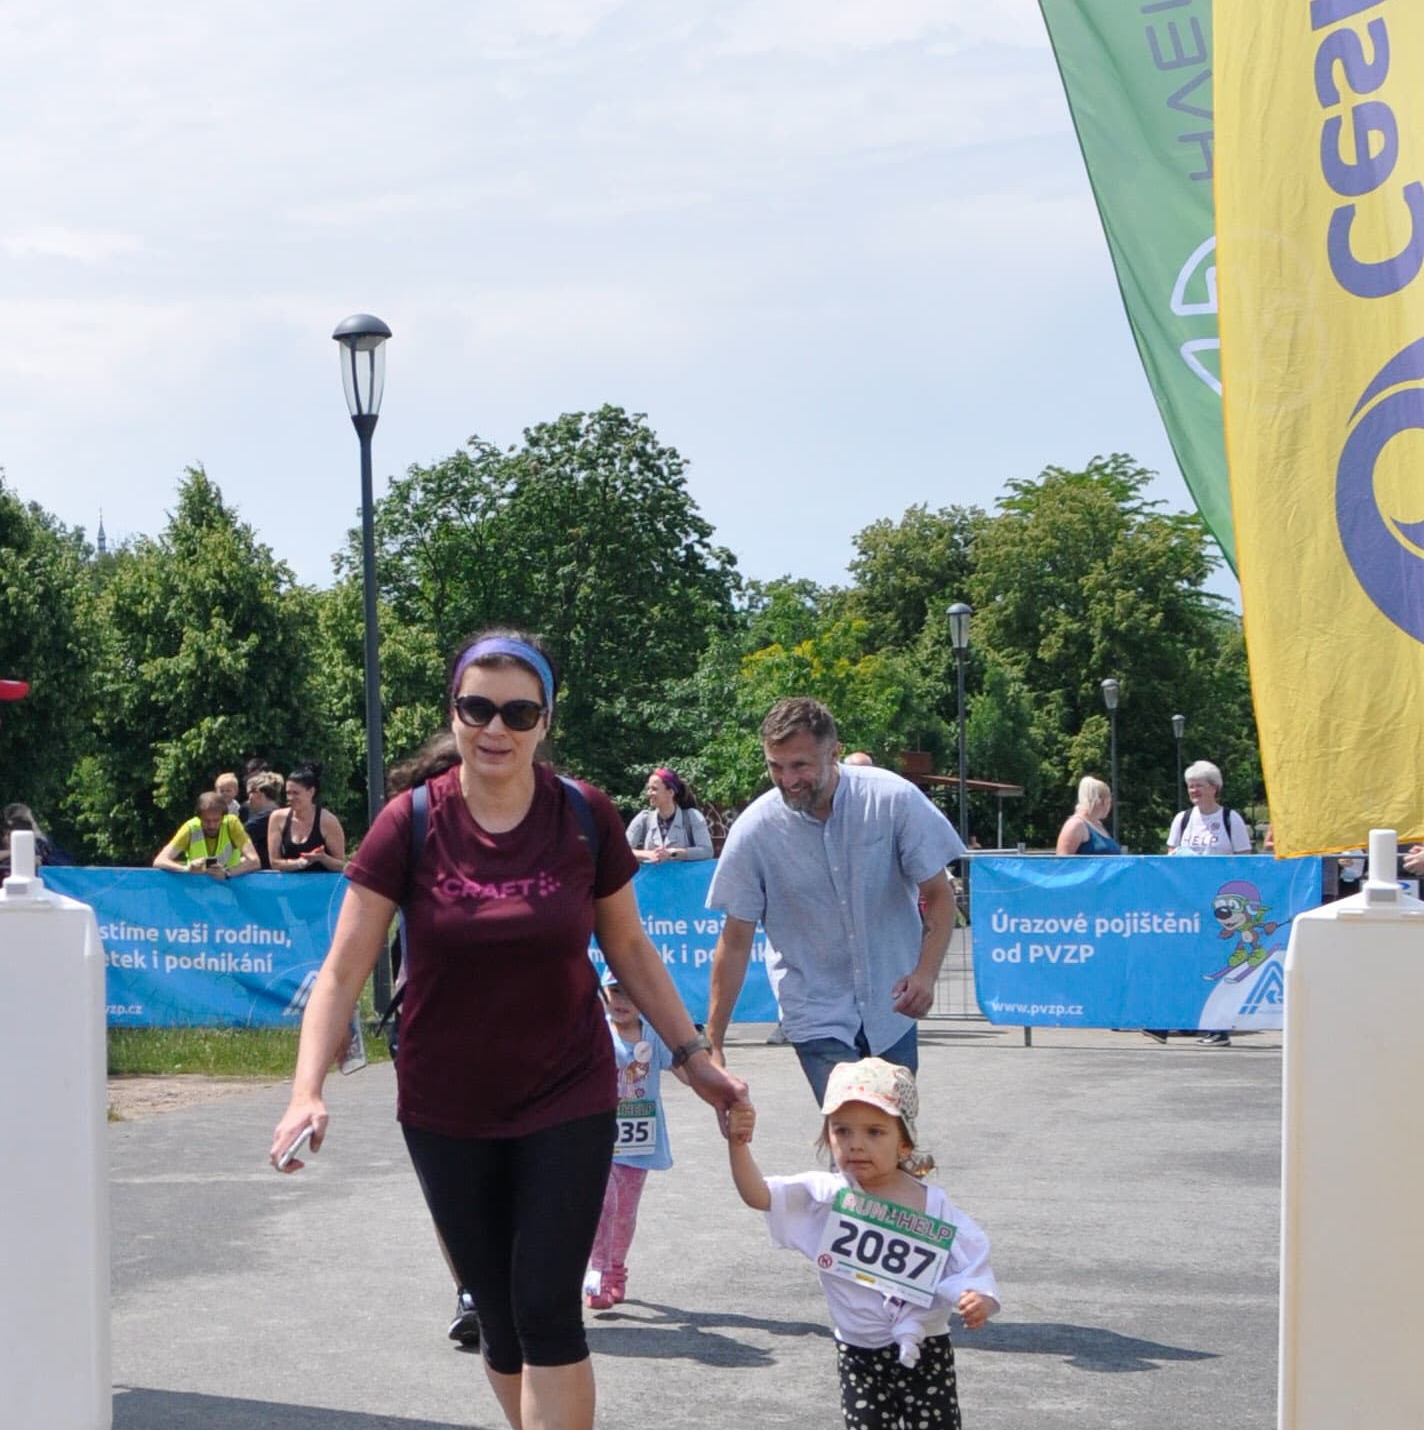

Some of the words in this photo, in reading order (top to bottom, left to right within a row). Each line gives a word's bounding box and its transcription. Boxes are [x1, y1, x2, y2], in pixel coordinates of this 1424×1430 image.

[442, 878, 535, 899] CRAFT
[165, 923, 208, 944] vaši
[215, 924, 292, 947] rodinu,
[992, 909, 1088, 934] Úrazové
[1095, 912, 1200, 937] pojištění
[152, 949, 159, 969] i
[165, 951, 273, 973] podnikání
[992, 943, 1021, 964] od
[1029, 944, 1095, 964] PVZP
[992, 1002, 1084, 1016] www.pvzp.cz
[616, 1121, 648, 1143] 35
[841, 1192, 888, 1221] RUN
[897, 1210, 953, 1242] HELP
[830, 1220, 937, 1280] 2087
